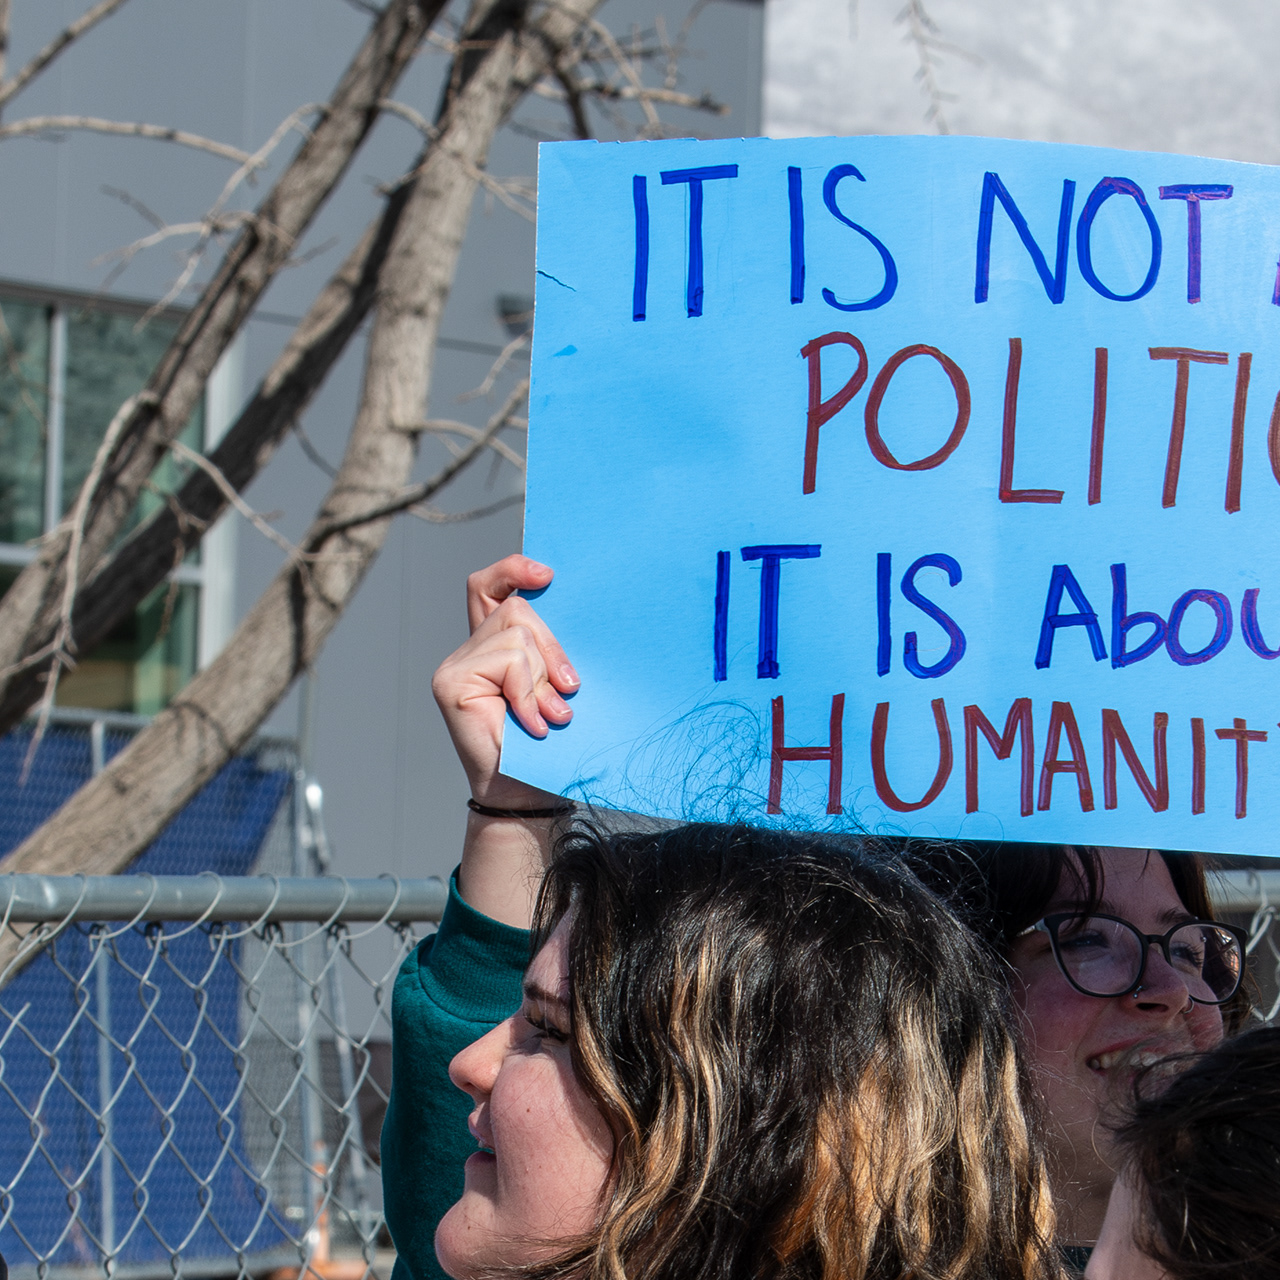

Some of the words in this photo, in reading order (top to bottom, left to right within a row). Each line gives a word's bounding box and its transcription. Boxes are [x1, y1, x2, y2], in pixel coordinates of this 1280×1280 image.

[632, 163, 740, 323] IT
[787, 163, 899, 313] IS
[974, 171, 1234, 305] NOT
[713, 543, 822, 683] IT
[876, 552, 967, 680] IS
